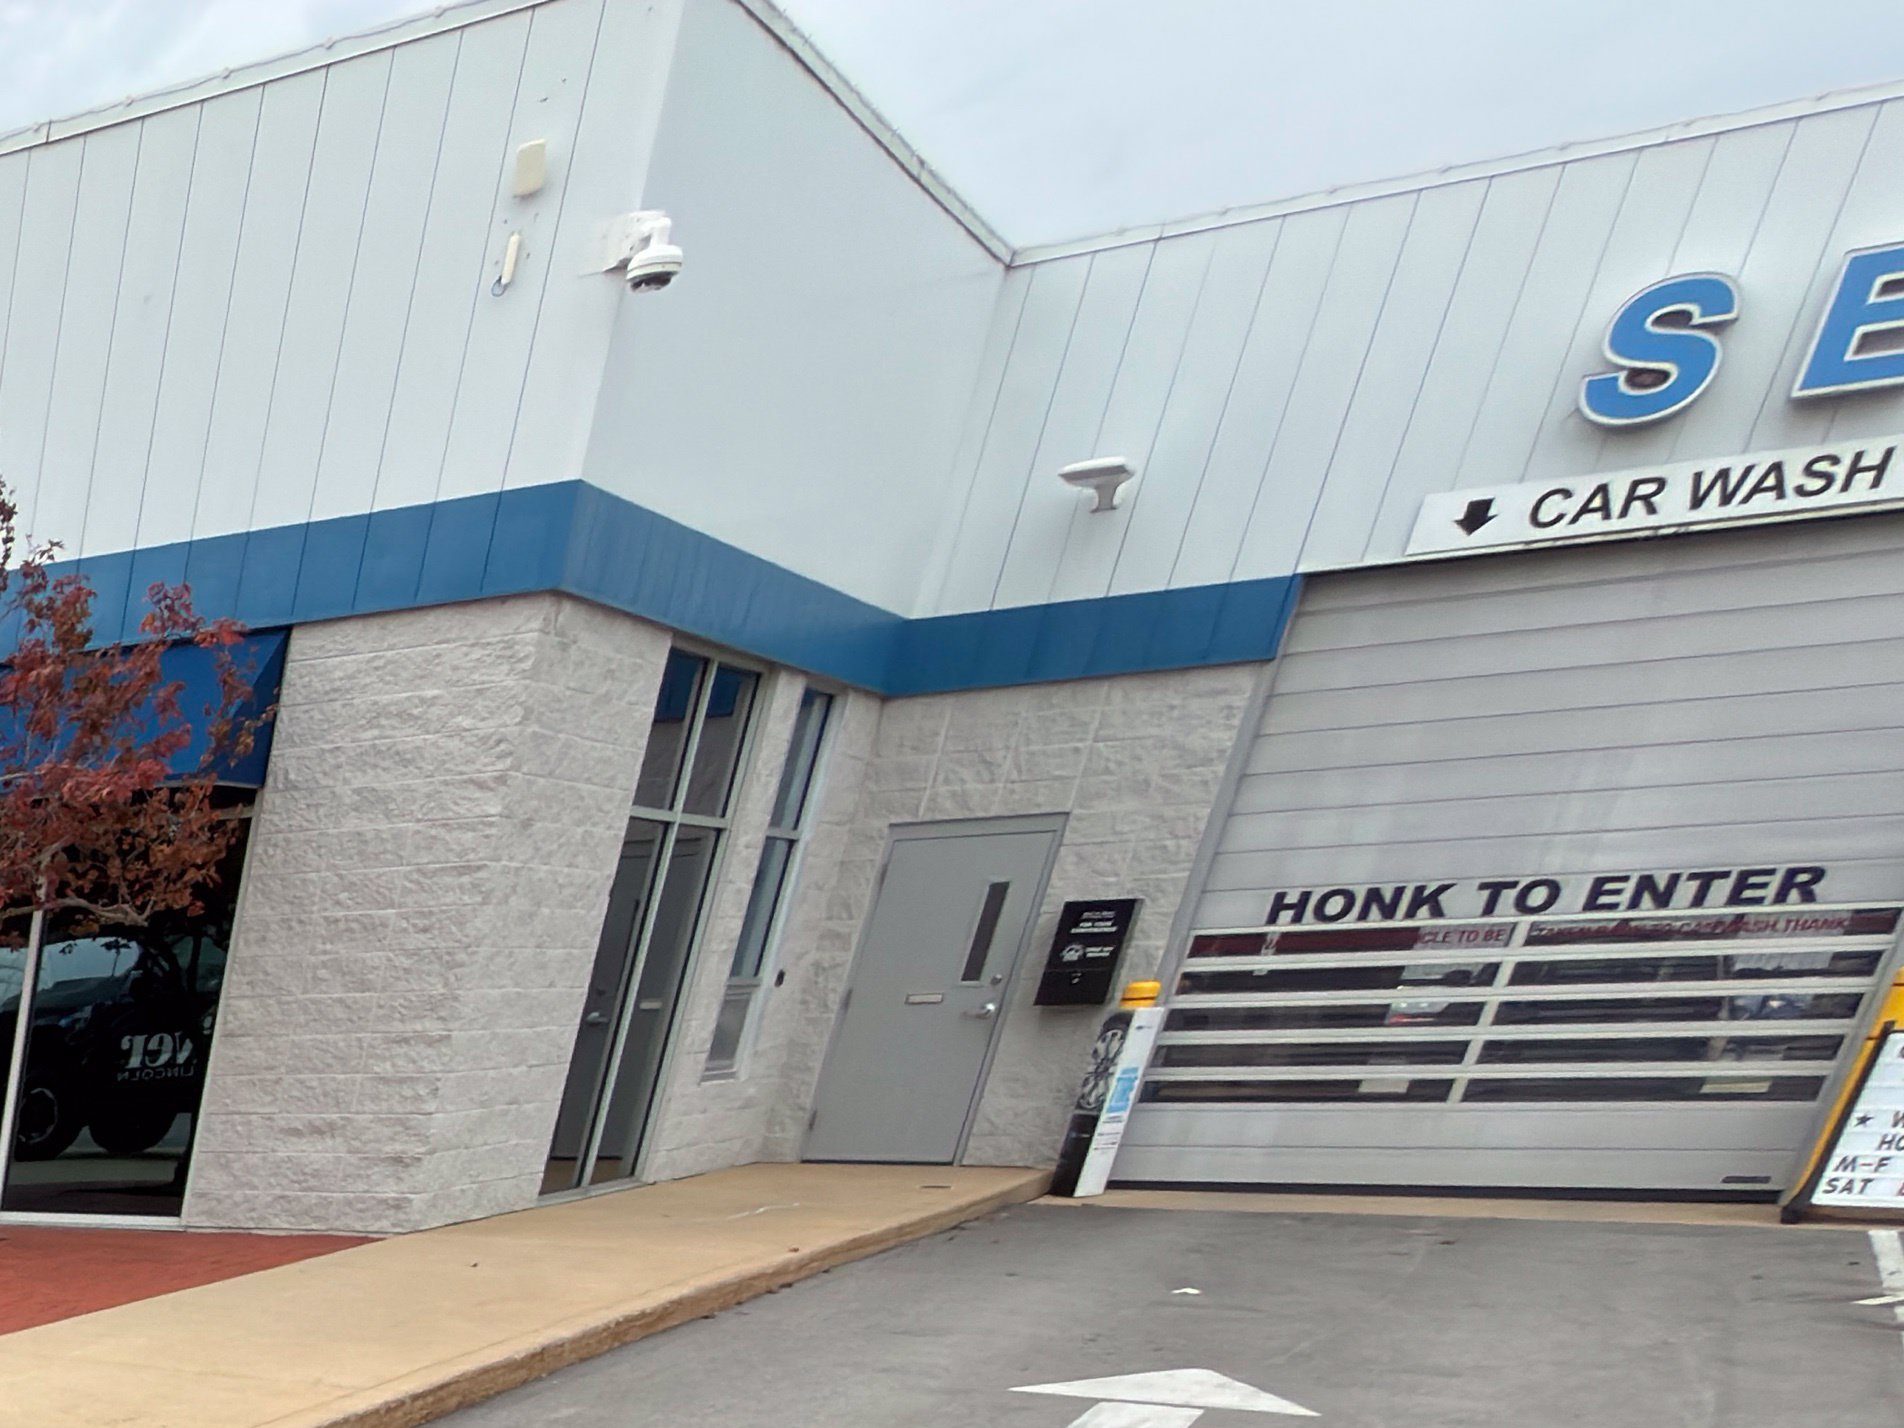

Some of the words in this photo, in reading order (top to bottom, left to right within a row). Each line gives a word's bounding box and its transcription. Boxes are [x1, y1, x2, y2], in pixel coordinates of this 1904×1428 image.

[1529, 476, 1667, 530] CAR
[1688, 446, 1898, 512] WASH
[1265, 882, 1457, 926] HONK
[1477, 878, 1562, 917] TO
[1582, 866, 1826, 912] ENTER
[1833, 1156, 1892, 1173] M-F
[1822, 1177, 1874, 1195] SAT
